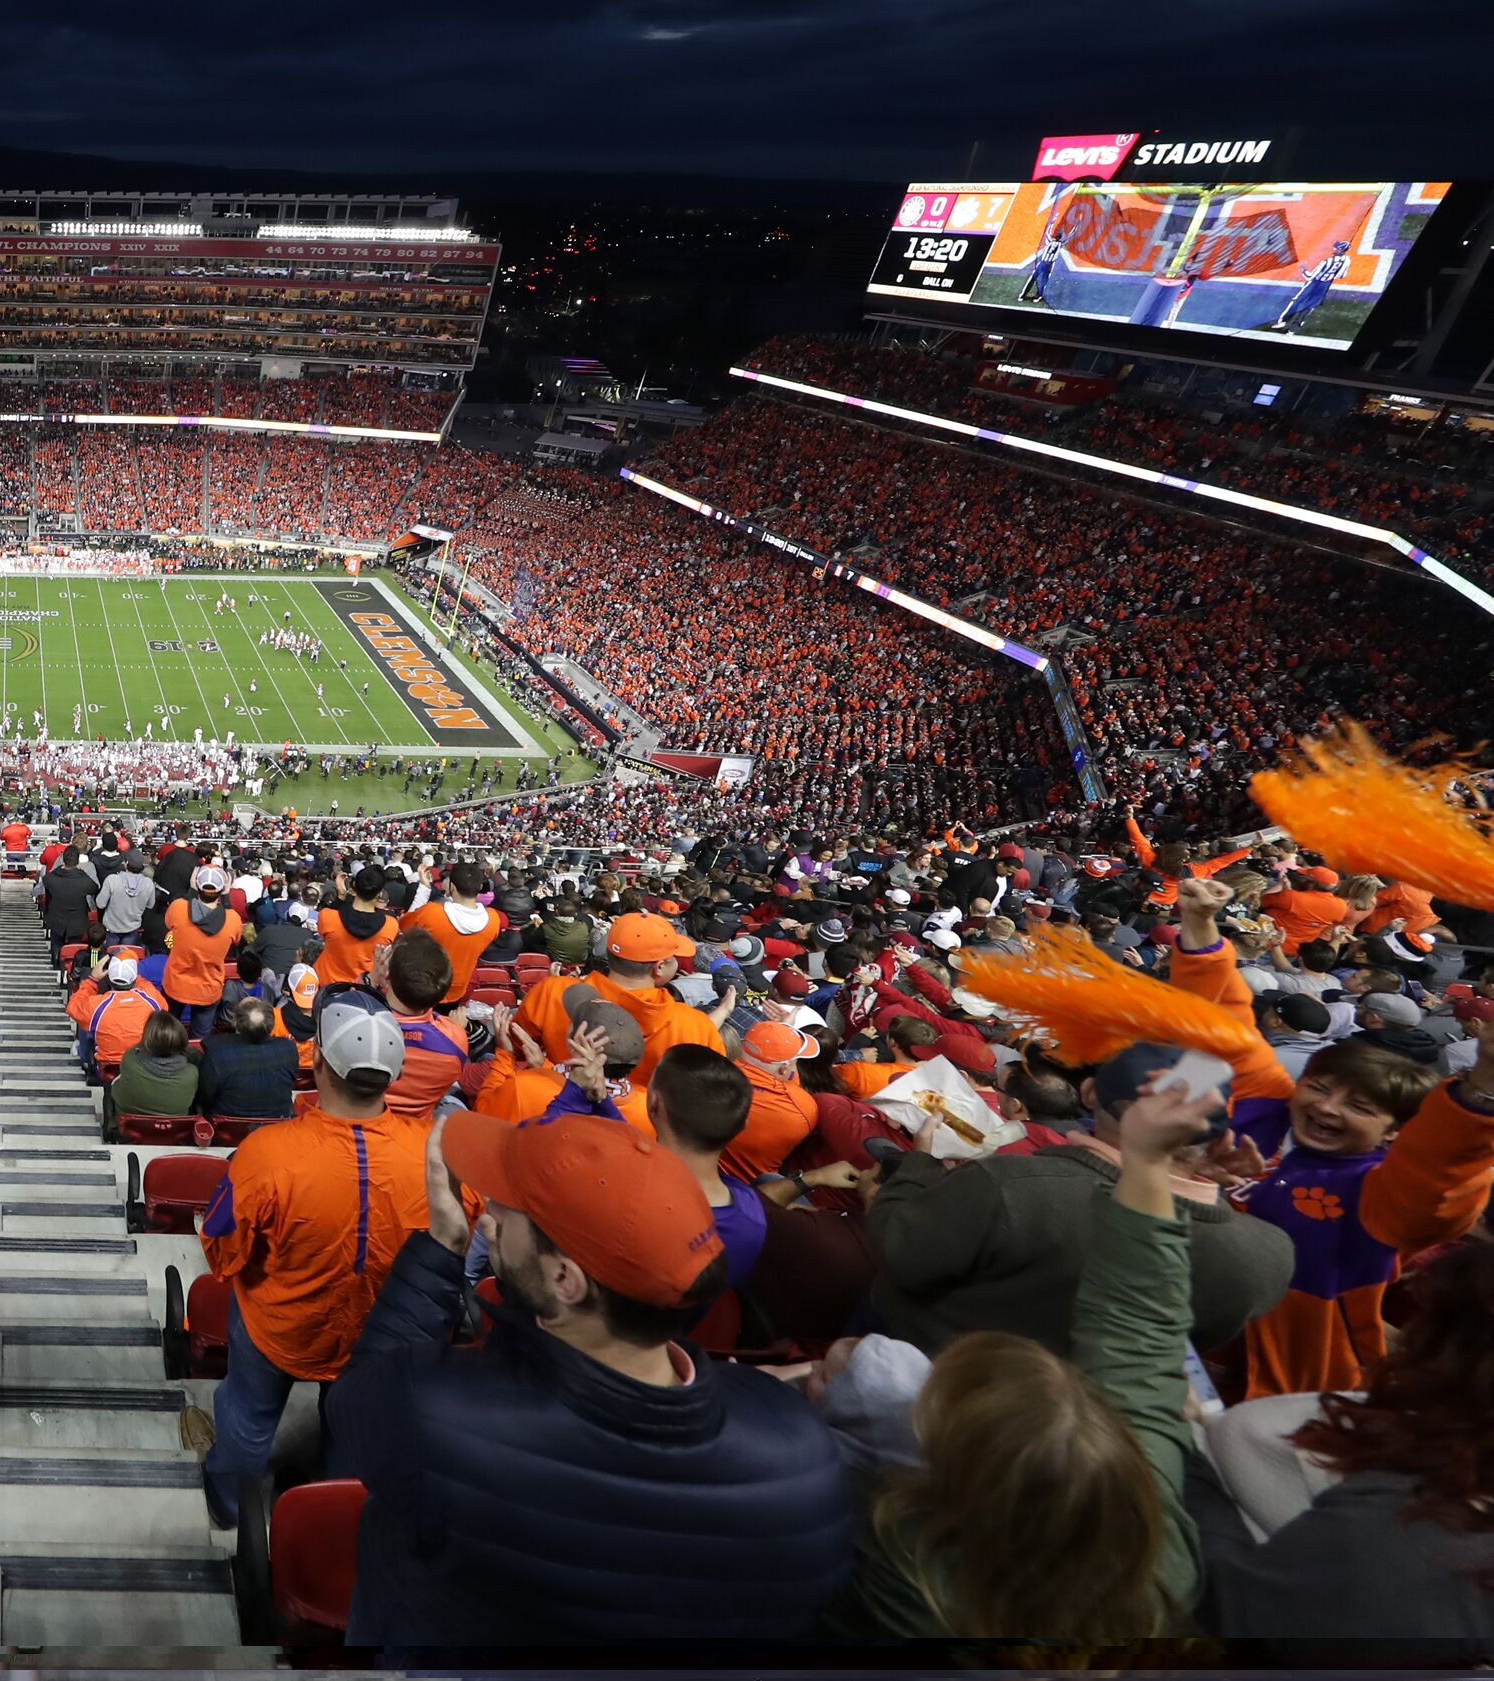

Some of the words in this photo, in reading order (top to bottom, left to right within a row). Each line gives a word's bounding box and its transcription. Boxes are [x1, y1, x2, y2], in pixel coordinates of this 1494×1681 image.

[1133, 140, 1272, 165] STADIUM
[930, 196, 948, 217] 0
[987, 197, 1005, 218] 7
[16, 242, 111, 251] CHAMPIONS
[120, 243, 147, 251] XXIV
[154, 244, 180, 252] XXIX
[903, 237, 969, 262] 13:20
[266, 246, 283, 254] 44
[310, 247, 326, 255] 70
[331, 247, 347, 255] 73
[353, 248, 369, 256] 74
[375, 248, 391, 256] 79
[397, 249, 415, 257] 80
[420, 249, 437, 257] 82
[443, 250, 461, 258] 87
[465, 251, 484, 259] 94
[24, 275, 84, 283] FAITHFUL
[922, 276, 940, 287] BALL
[940, 278, 954, 288] ON
[847, 571, 855, 581] 7
[348, 612, 490, 730] CLEMSON
[153, 704, 181, 715] 30
[234, 705, 264, 716] 20
[317, 707, 344, 717] 10
